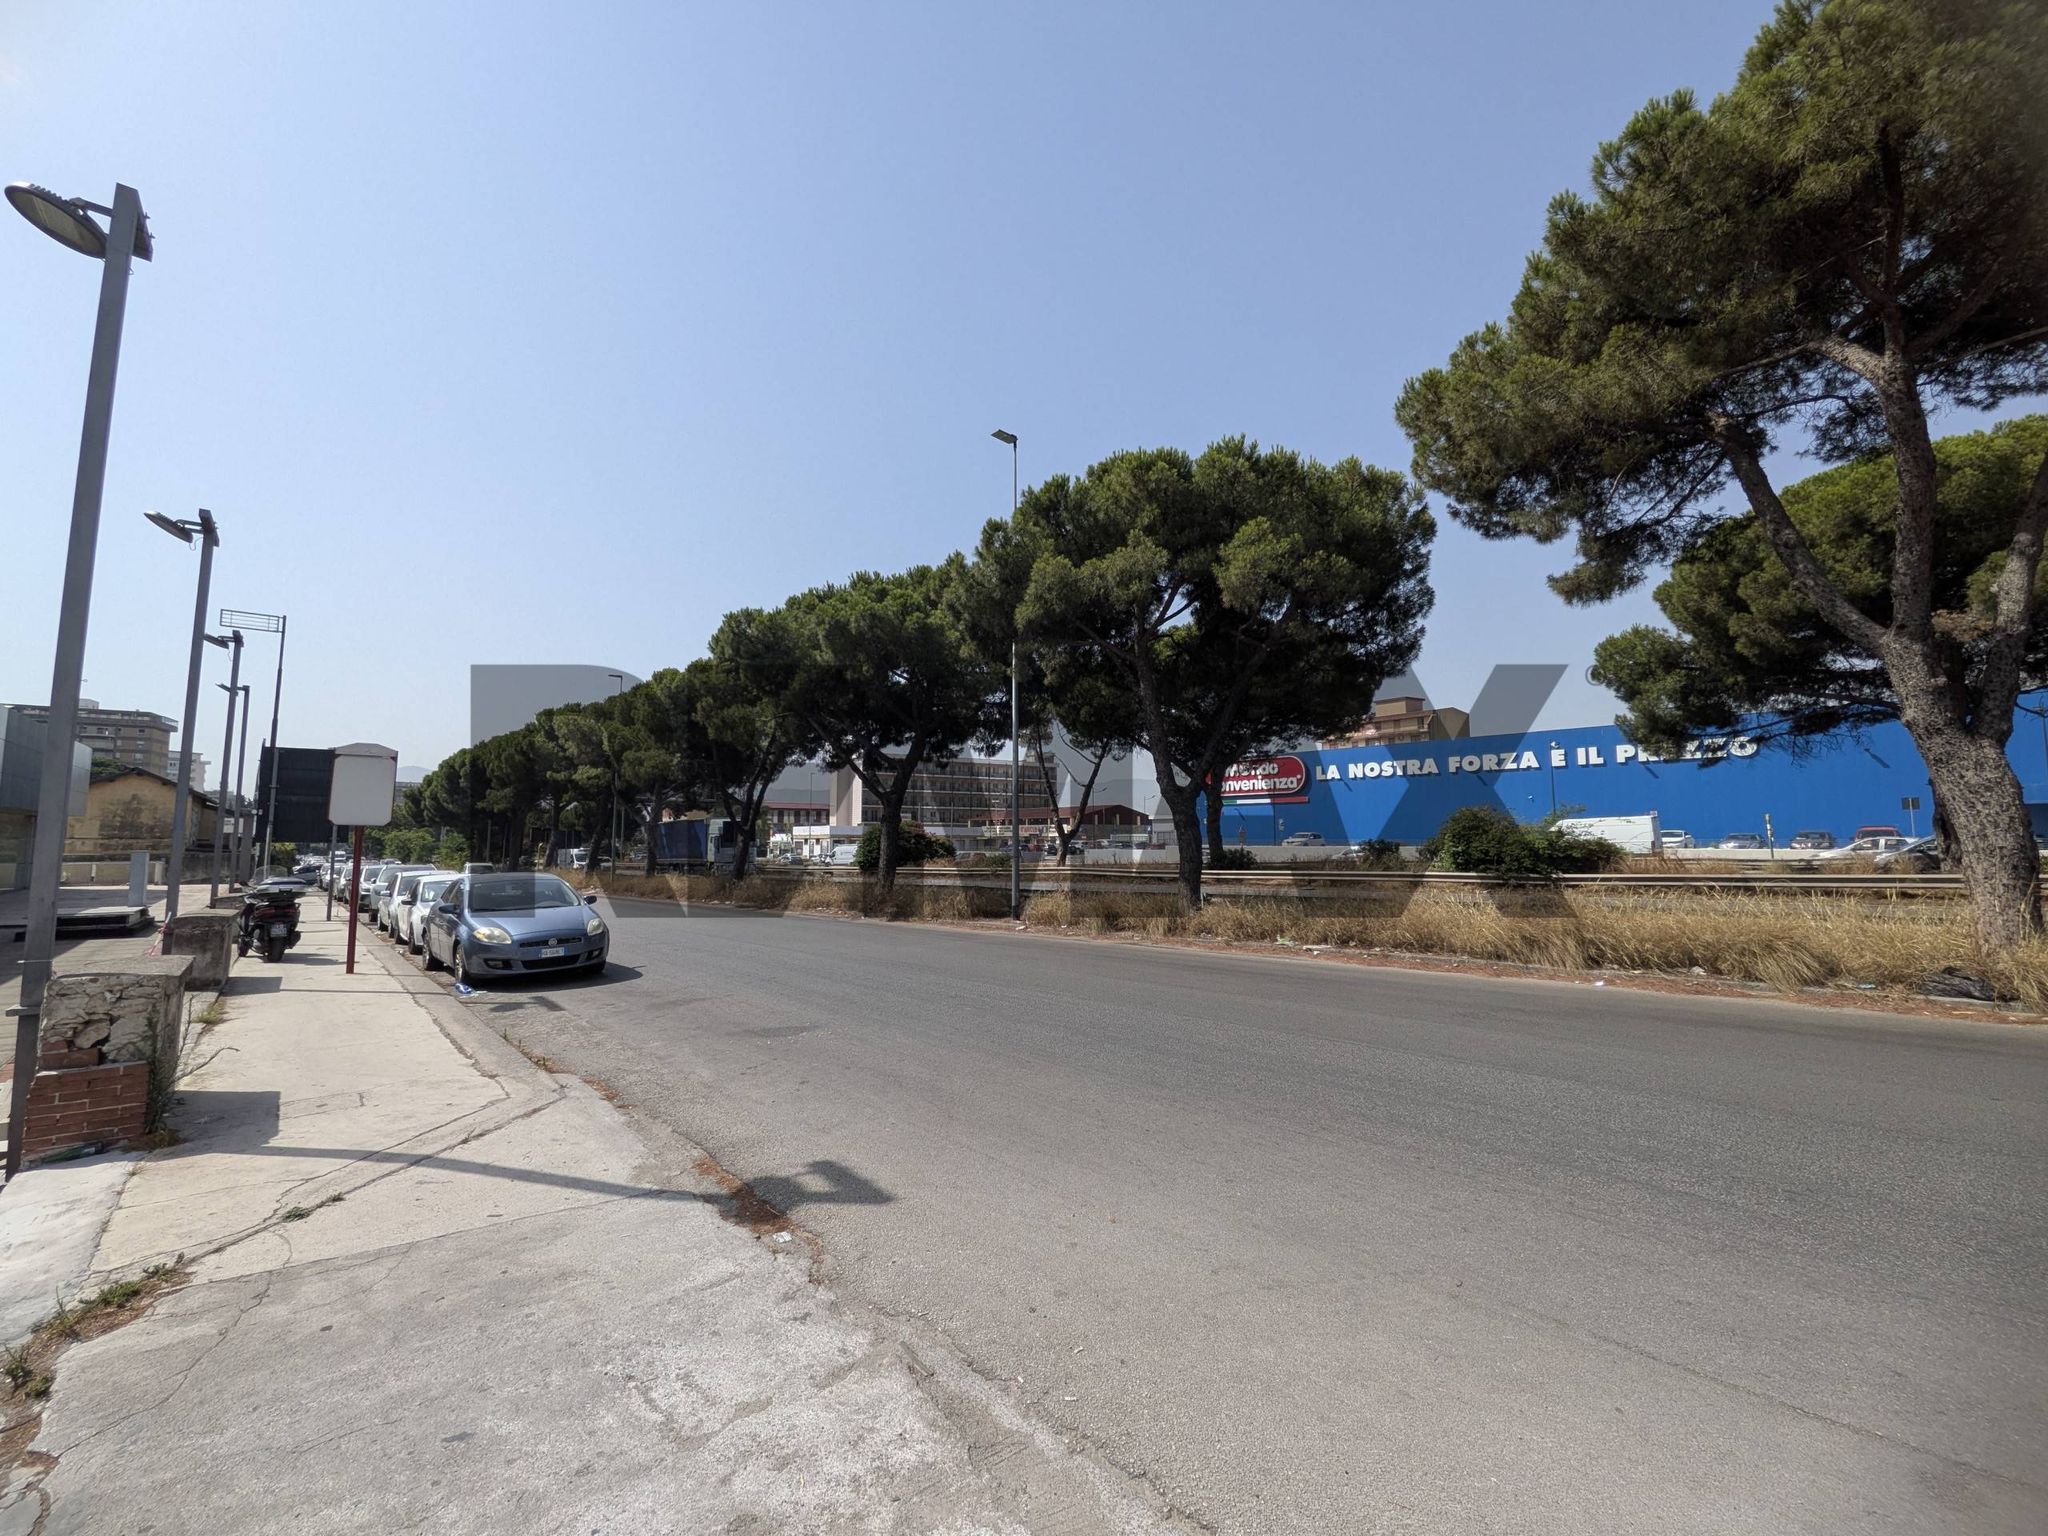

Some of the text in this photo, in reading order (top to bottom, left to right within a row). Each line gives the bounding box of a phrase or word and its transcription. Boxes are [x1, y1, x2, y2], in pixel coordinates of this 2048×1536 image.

[1316, 764, 1340, 780] LA
[1350, 759, 1438, 779] NOSTRA
[1449, 752, 1540, 773] FORZA
[1577, 747, 1604, 766] IL
